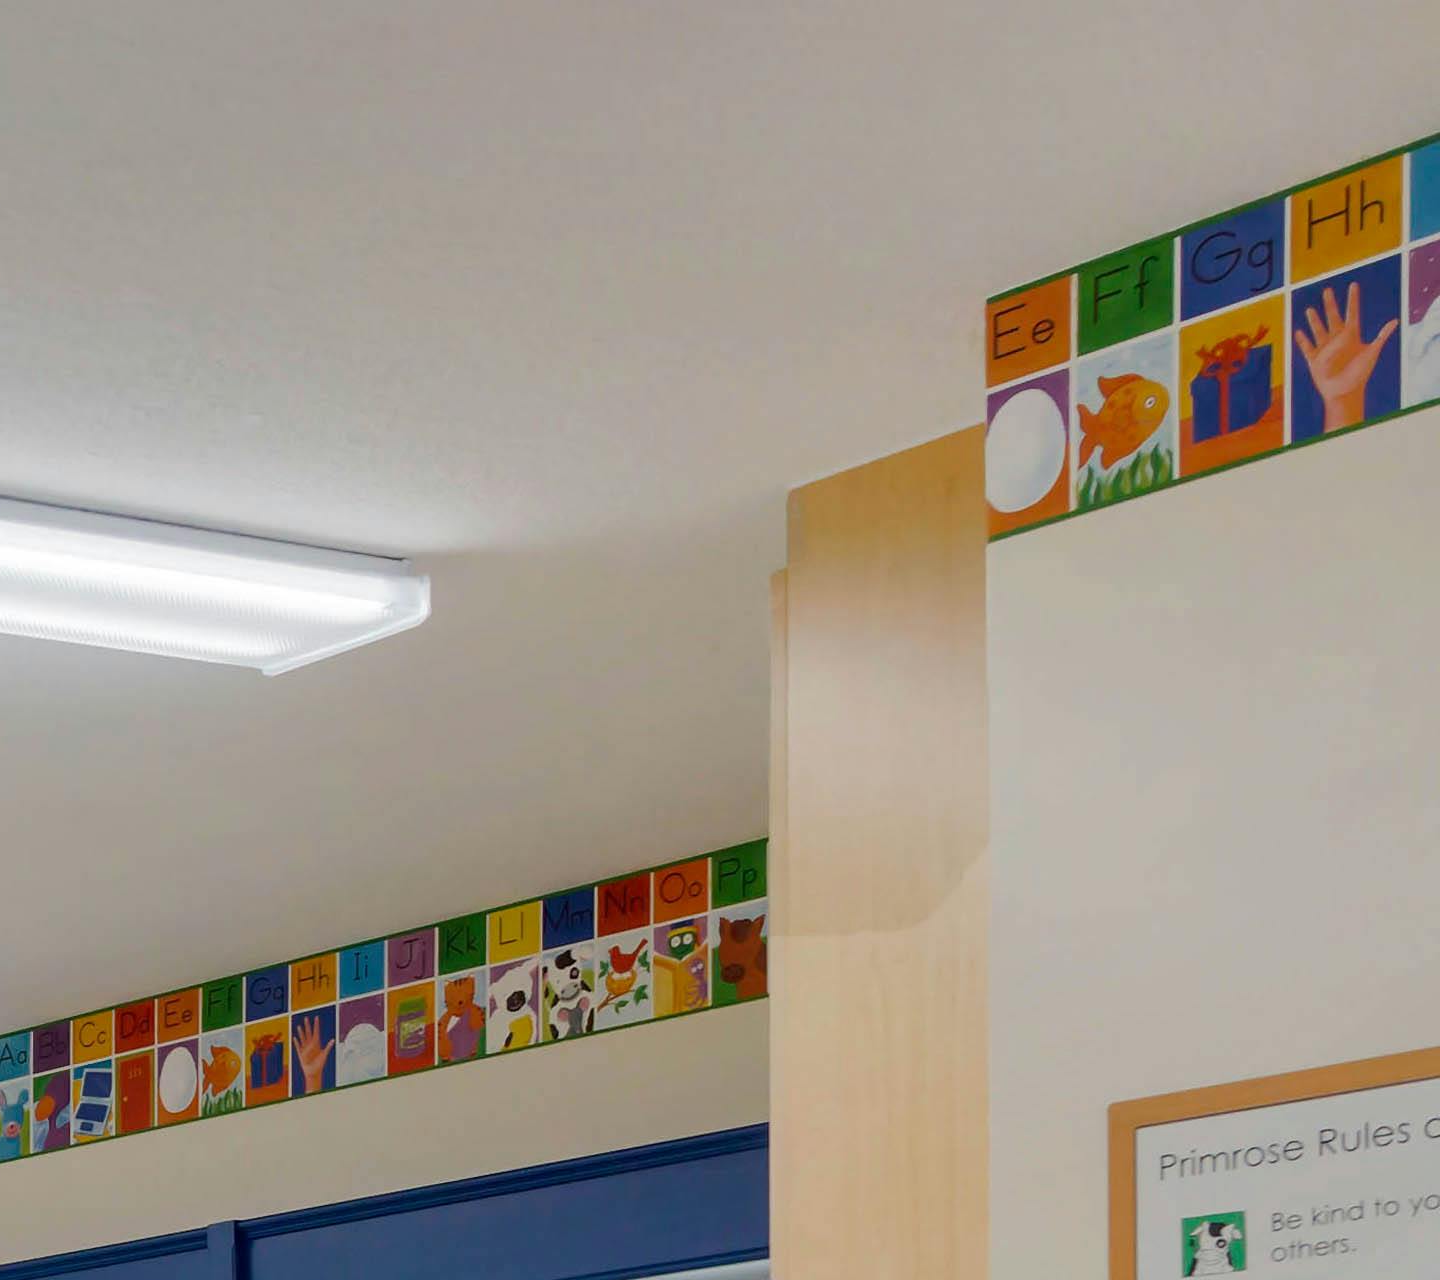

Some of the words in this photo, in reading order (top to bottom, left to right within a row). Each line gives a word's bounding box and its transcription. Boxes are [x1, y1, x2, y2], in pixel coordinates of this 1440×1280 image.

[992, 301, 1056, 361] Ee
[1092, 253, 1160, 326] Ff
[1188, 230, 1275, 293] Gg
[1304, 179, 1387, 250] Hh
[78, 1022, 108, 1049] Cc
[119, 1010, 151, 1042] Dd
[164, 998, 194, 1029] Ee
[207, 984, 235, 1017] Ff
[296, 963, 330, 994] Hh
[353, 951, 370, 982] Ii
[395, 937, 427, 980] Jj
[445, 929, 479, 957] Kk
[497, 910, 525, 946] Ll
[658, 871, 704, 904] Oo
[717, 857, 758, 896] Pp
[1159, 1139, 1305, 1181] Primrose
[1317, 1121, 1412, 1156] Rules
[1270, 1210, 1303, 1232] Be
[1311, 1203, 1365, 1227] kind
[1374, 1196, 1401, 1217] to
[1270, 1237, 1358, 1262] others.
